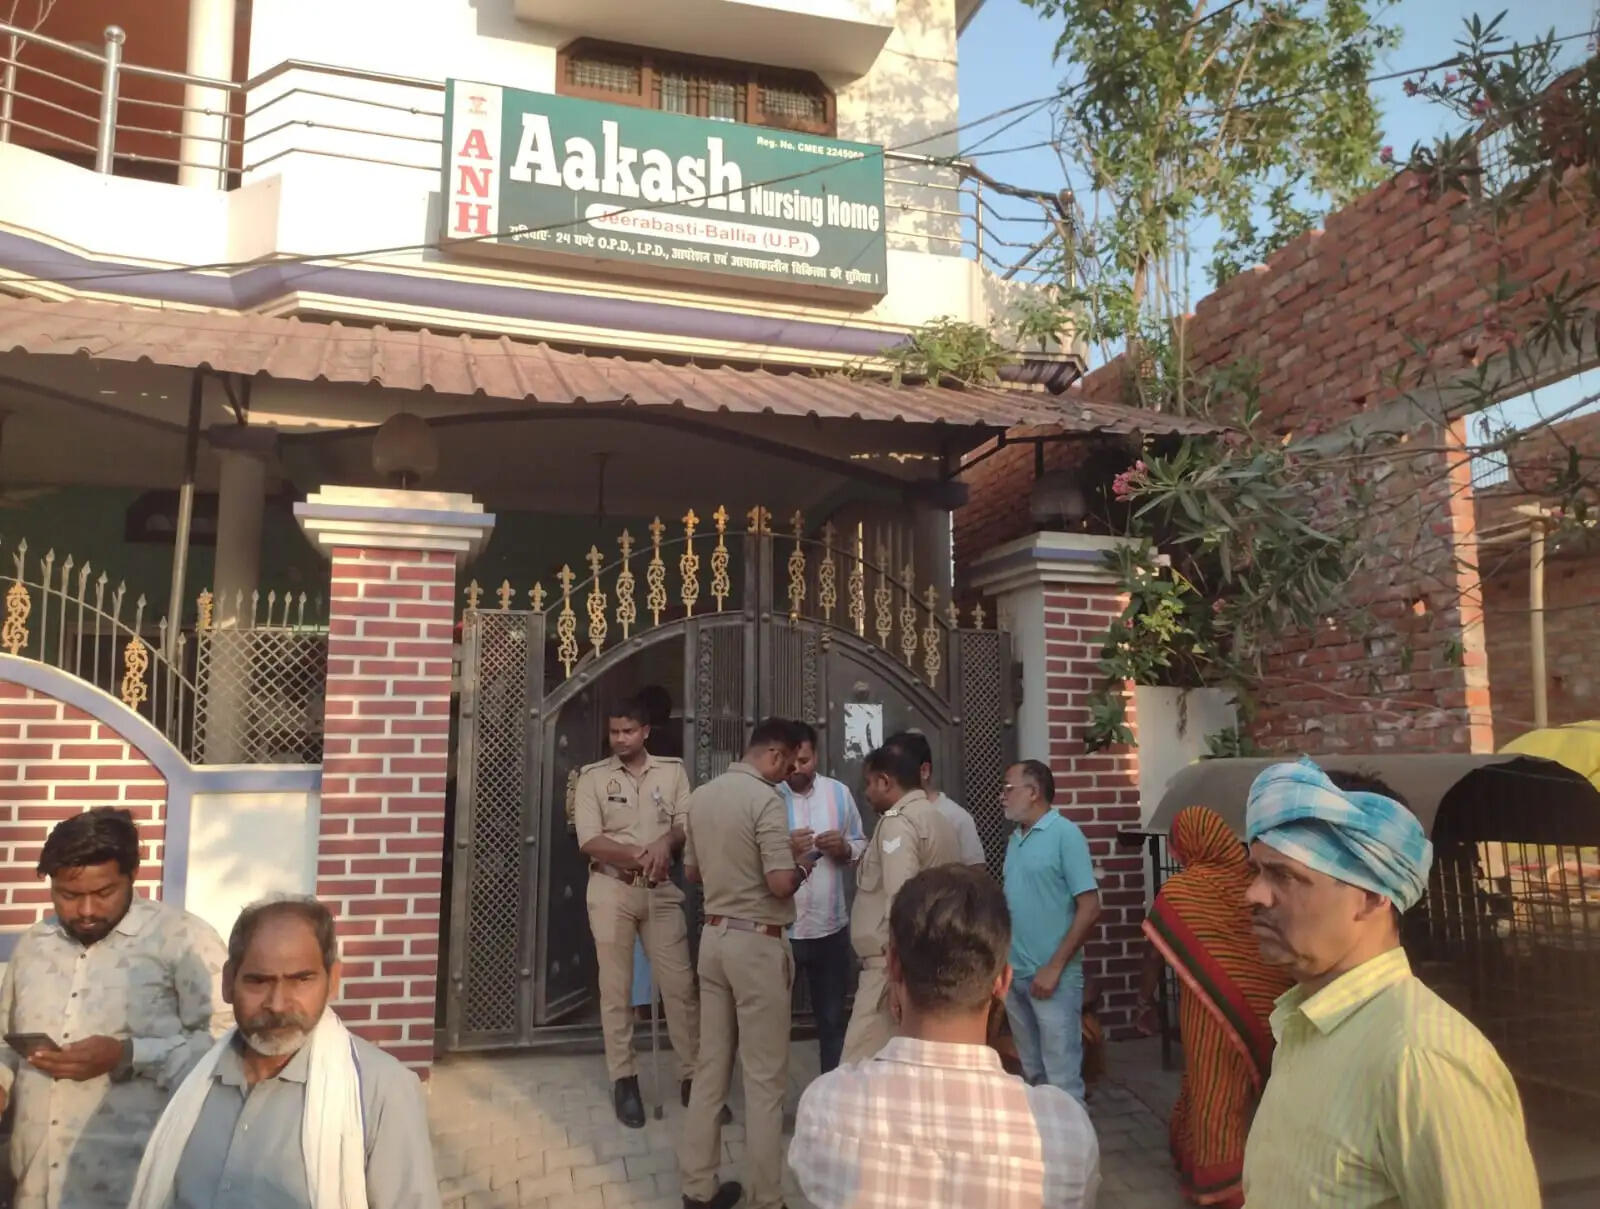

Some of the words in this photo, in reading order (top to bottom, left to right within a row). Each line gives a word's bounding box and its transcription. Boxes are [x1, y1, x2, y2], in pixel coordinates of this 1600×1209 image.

[756, 135, 778, 149] Reg.
[454, 129, 493, 237] ANH
[509, 112, 746, 214] Aakash
[750, 182, 824, 227] Nursing
[827, 194, 880, 232] Home
[763, 230, 809, 252] (U.P.)
[713, 252, 729, 265] एवं
[829, 266, 842, 280] की
